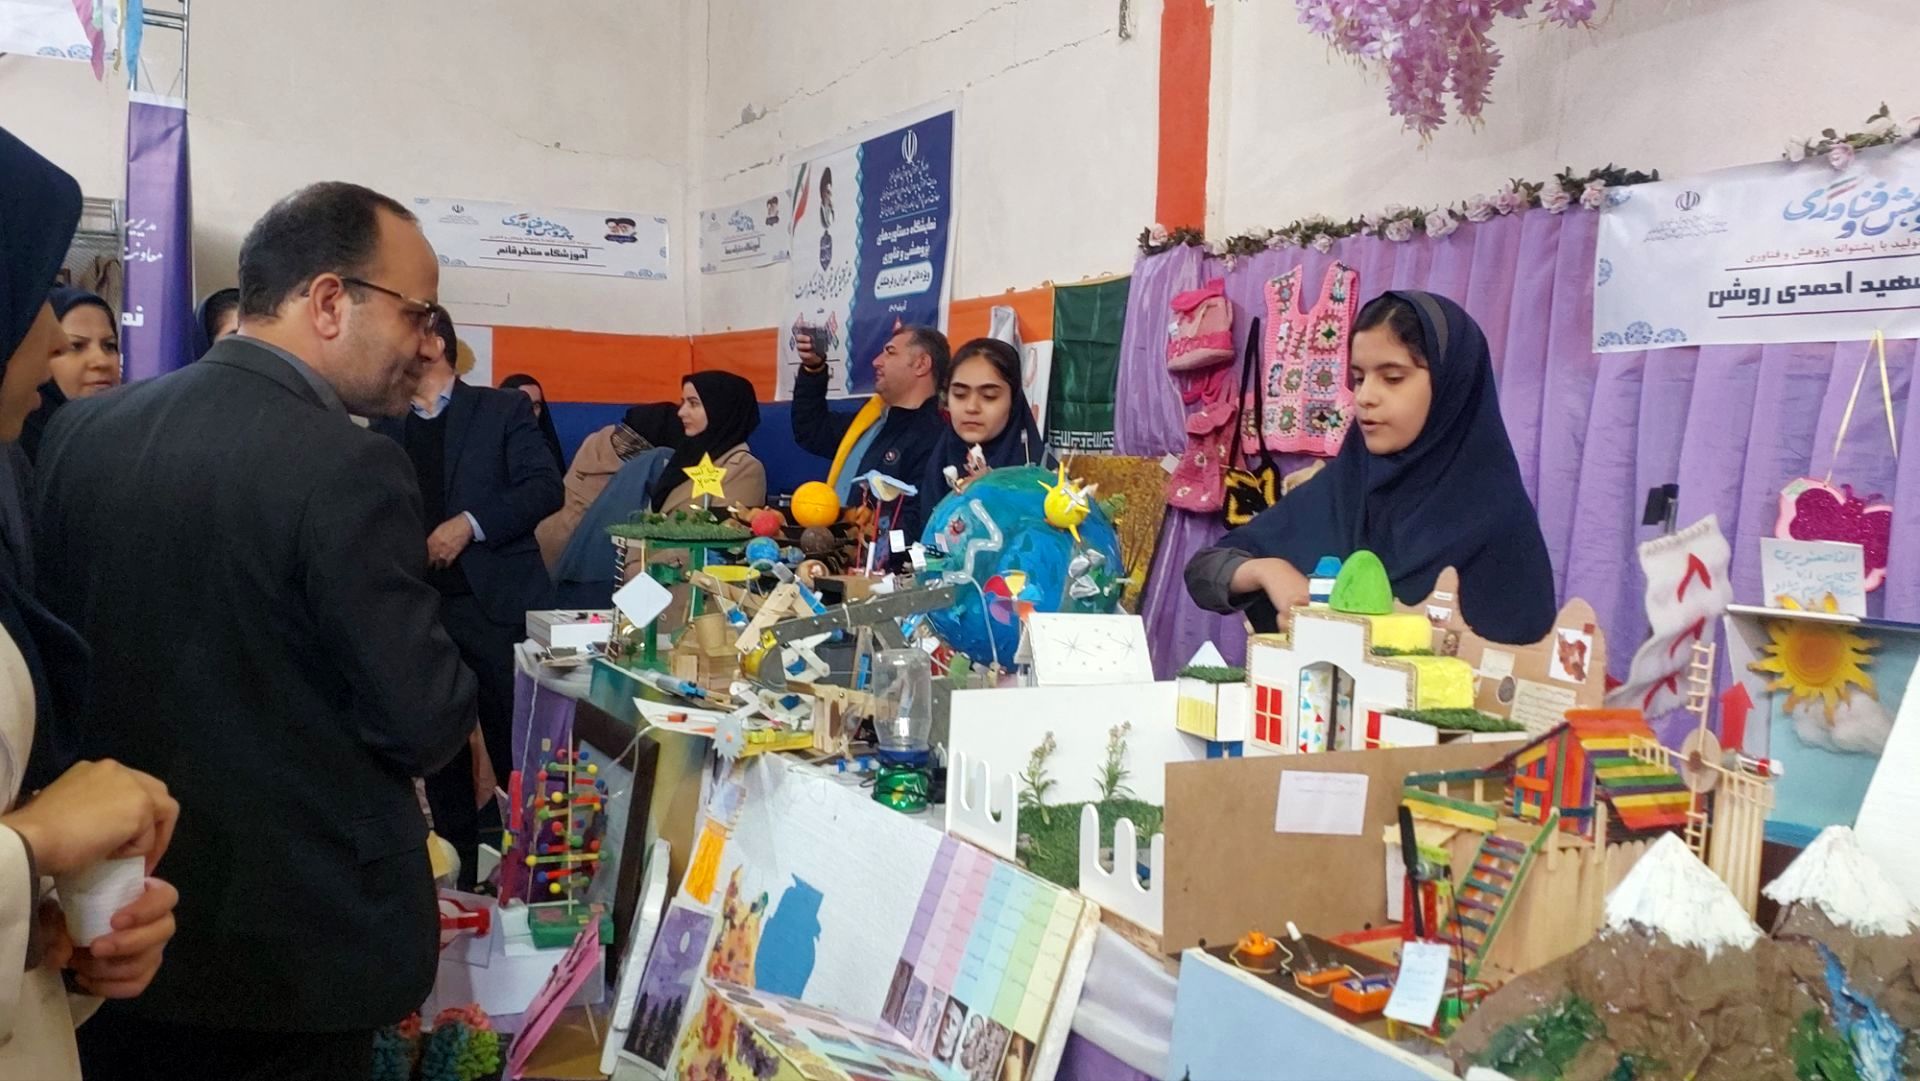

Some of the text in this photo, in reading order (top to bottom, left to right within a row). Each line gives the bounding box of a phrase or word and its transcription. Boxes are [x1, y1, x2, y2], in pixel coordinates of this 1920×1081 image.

[1782, 177, 1888, 222] فناوری
[910, 216, 937, 234] نمایشگاه
[1792, 245, 1829, 260] پژوهش
[1891, 238, 1920, 251] ولید
[544, 248, 588, 261] آموزشگاه
[1745, 250, 1780, 264] فناوری
[1709, 277, 1771, 308] روشن
[1777, 271, 1853, 304] احمدی
